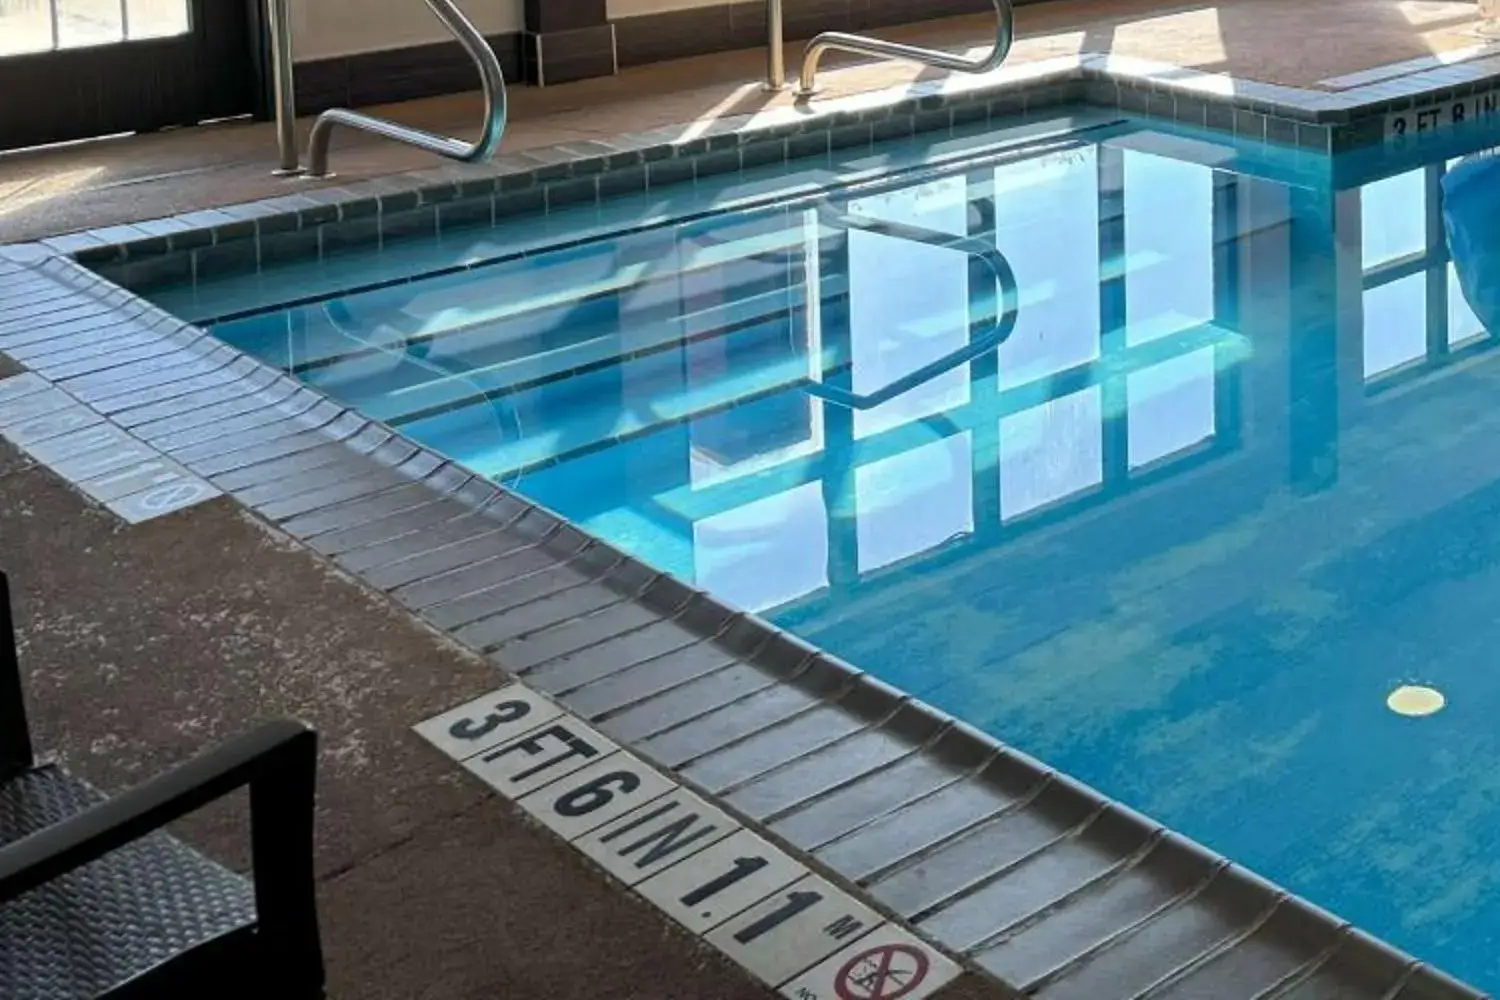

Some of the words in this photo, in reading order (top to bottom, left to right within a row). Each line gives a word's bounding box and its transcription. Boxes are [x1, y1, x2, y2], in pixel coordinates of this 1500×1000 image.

[449, 699, 531, 739] 3
[482, 724, 598, 783] FT
[554, 769, 641, 817] 6
[599, 800, 716, 868] IN
